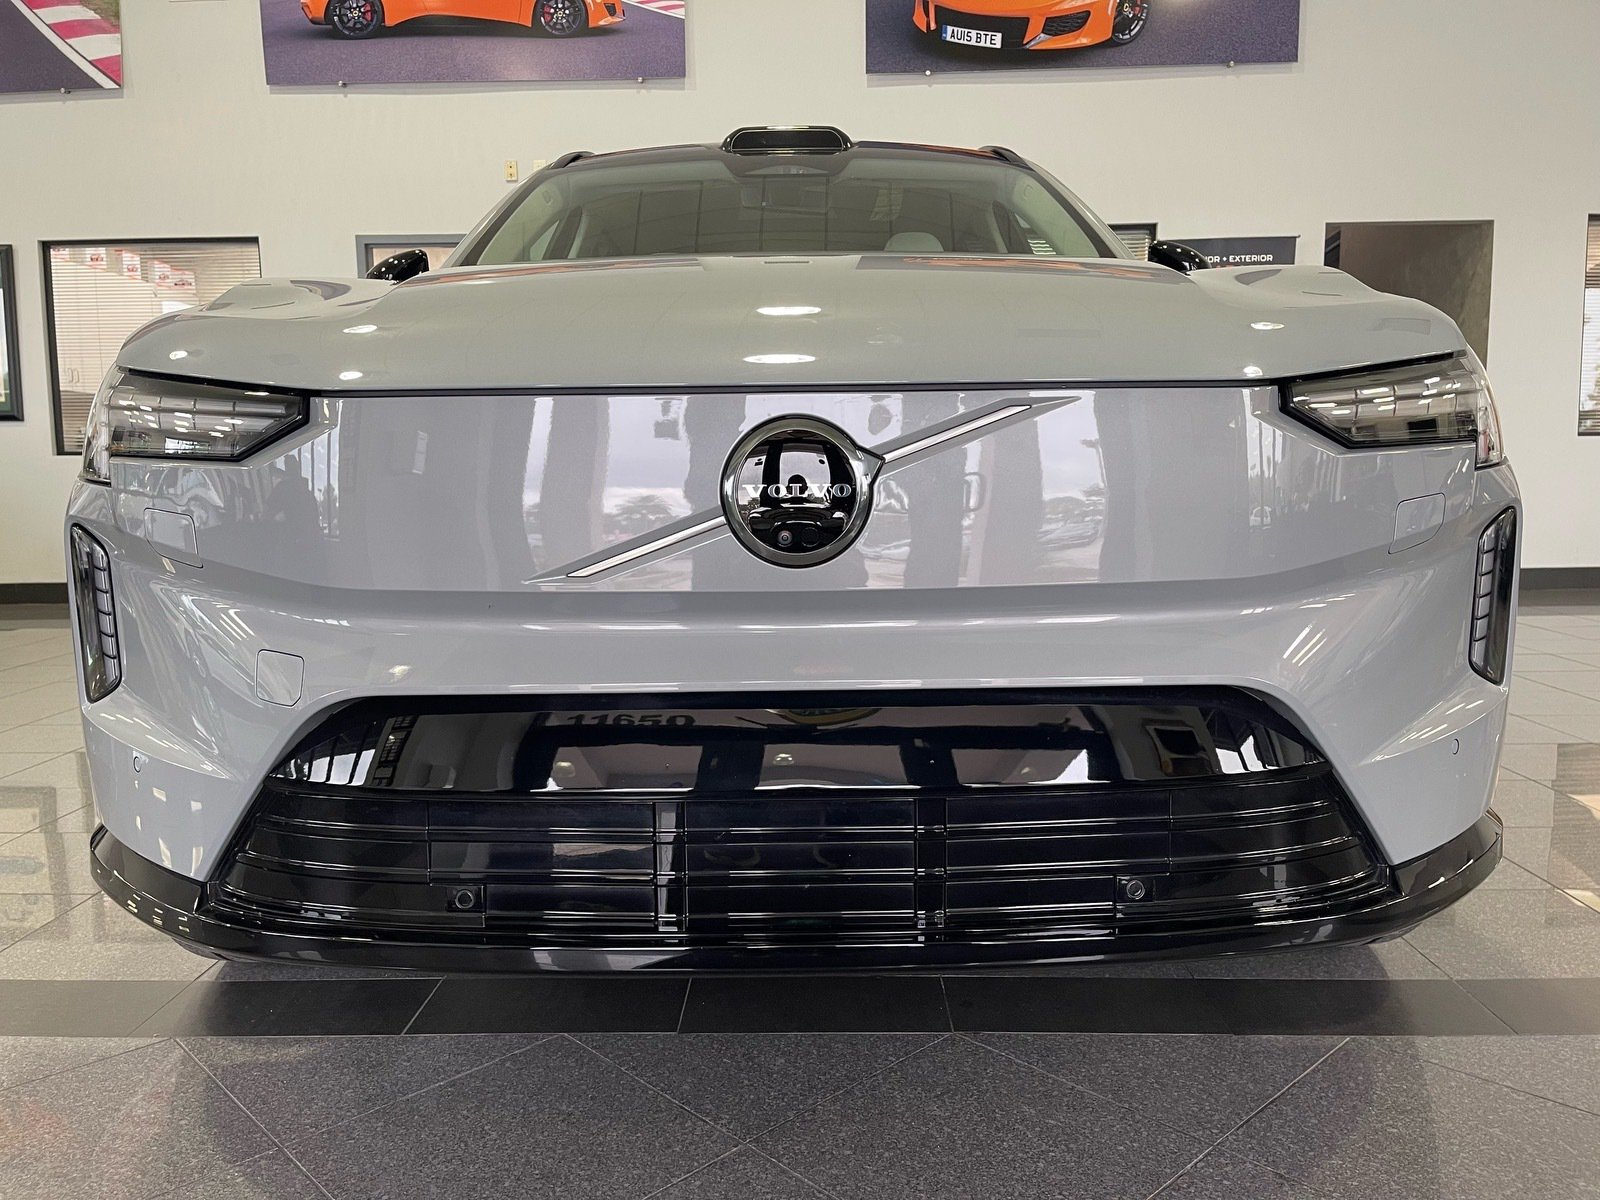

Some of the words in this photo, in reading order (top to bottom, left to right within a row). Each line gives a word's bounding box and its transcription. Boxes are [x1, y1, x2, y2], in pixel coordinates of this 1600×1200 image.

[950, 28, 972, 42] AU15
[975, 32, 997, 46] BTE
[1229, 254, 1273, 263] EXTERIOR
[742, 483, 852, 498] VOLVO
